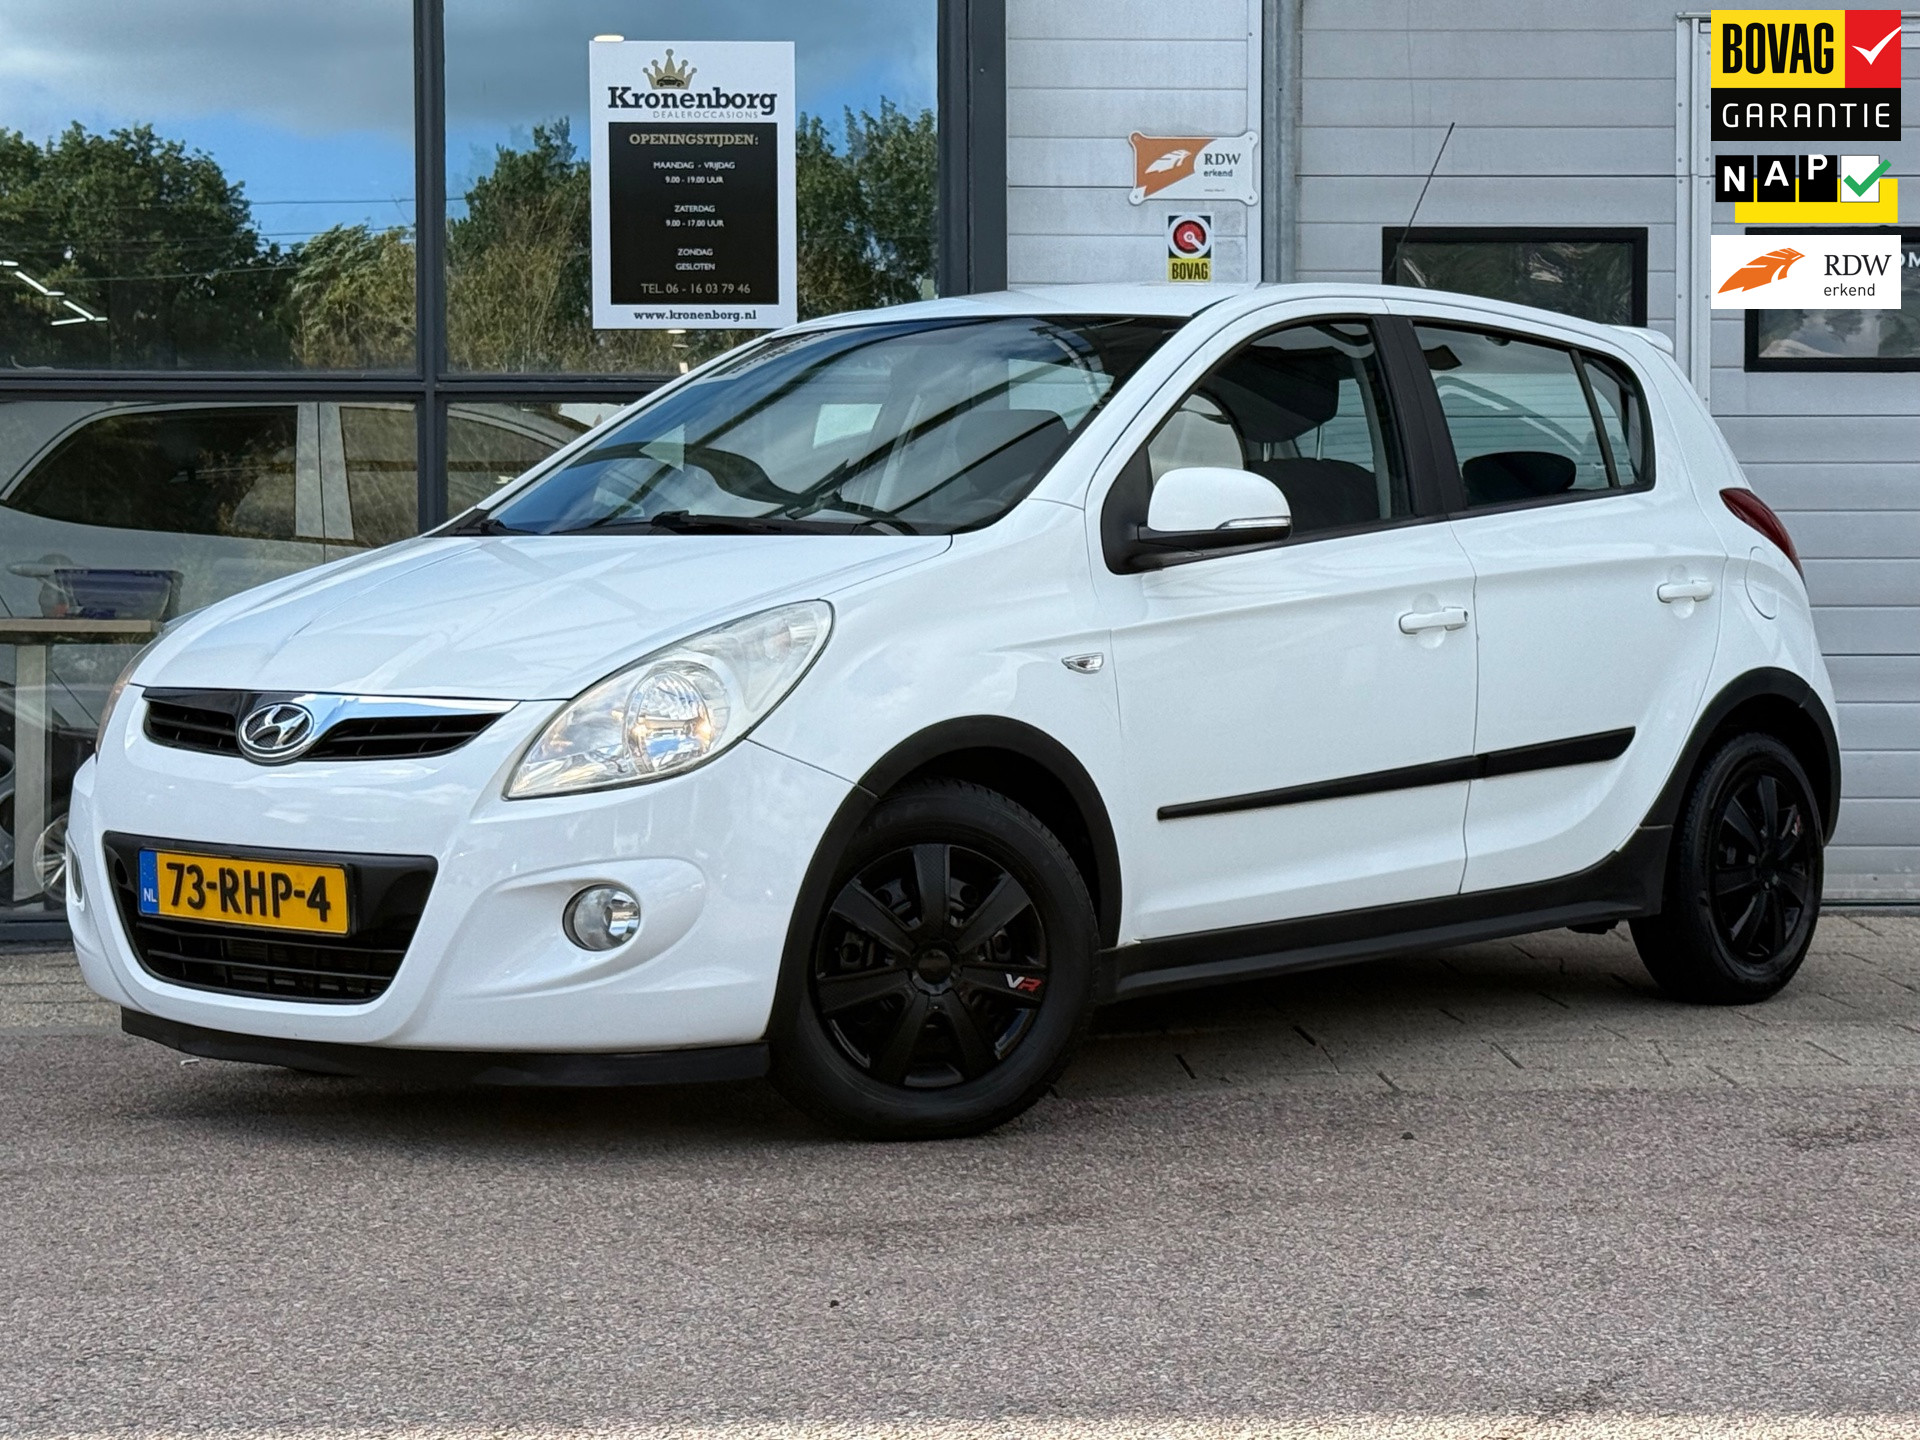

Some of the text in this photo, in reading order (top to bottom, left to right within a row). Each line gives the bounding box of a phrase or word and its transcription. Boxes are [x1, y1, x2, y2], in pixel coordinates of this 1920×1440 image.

[607, 86, 778, 116] Kronenborg
[653, 110, 759, 119] DEALEROCCASIONS
[629, 133, 759, 148] OPENINGSTIJDEN:
[1204, 153, 1241, 166] RDW
[653, 161, 695, 169] MAANDAG
[703, 161, 736, 171] VRIJDAG
[1203, 168, 1234, 177] erkend
[665, 175, 681, 183] 9.00
[687, 175, 705, 183] 19.00
[706, 175, 724, 183] UUR
[674, 204, 716, 213] ZATERDAG
[665, 219, 681, 227] 9.00
[687, 219, 705, 227] 17.00
[706, 219, 724, 227] UUR
[677, 248, 713, 256] ZONDAG
[675, 262, 716, 270] GESLOTEN
[1171, 262, 1209, 280] BOVAG
[640, 283, 664, 294] TEL.
[665, 283, 679, 294] 06
[691, 283, 703, 294] 16
[705, 283, 718, 294] 03
[721, 283, 734, 294] 79
[737, 283, 751, 294] 46
[633, 309, 757, 322] www.kronenborg.nl
[143, 887, 158, 903] NL
[165, 862, 332, 922] 73-RHP-4
